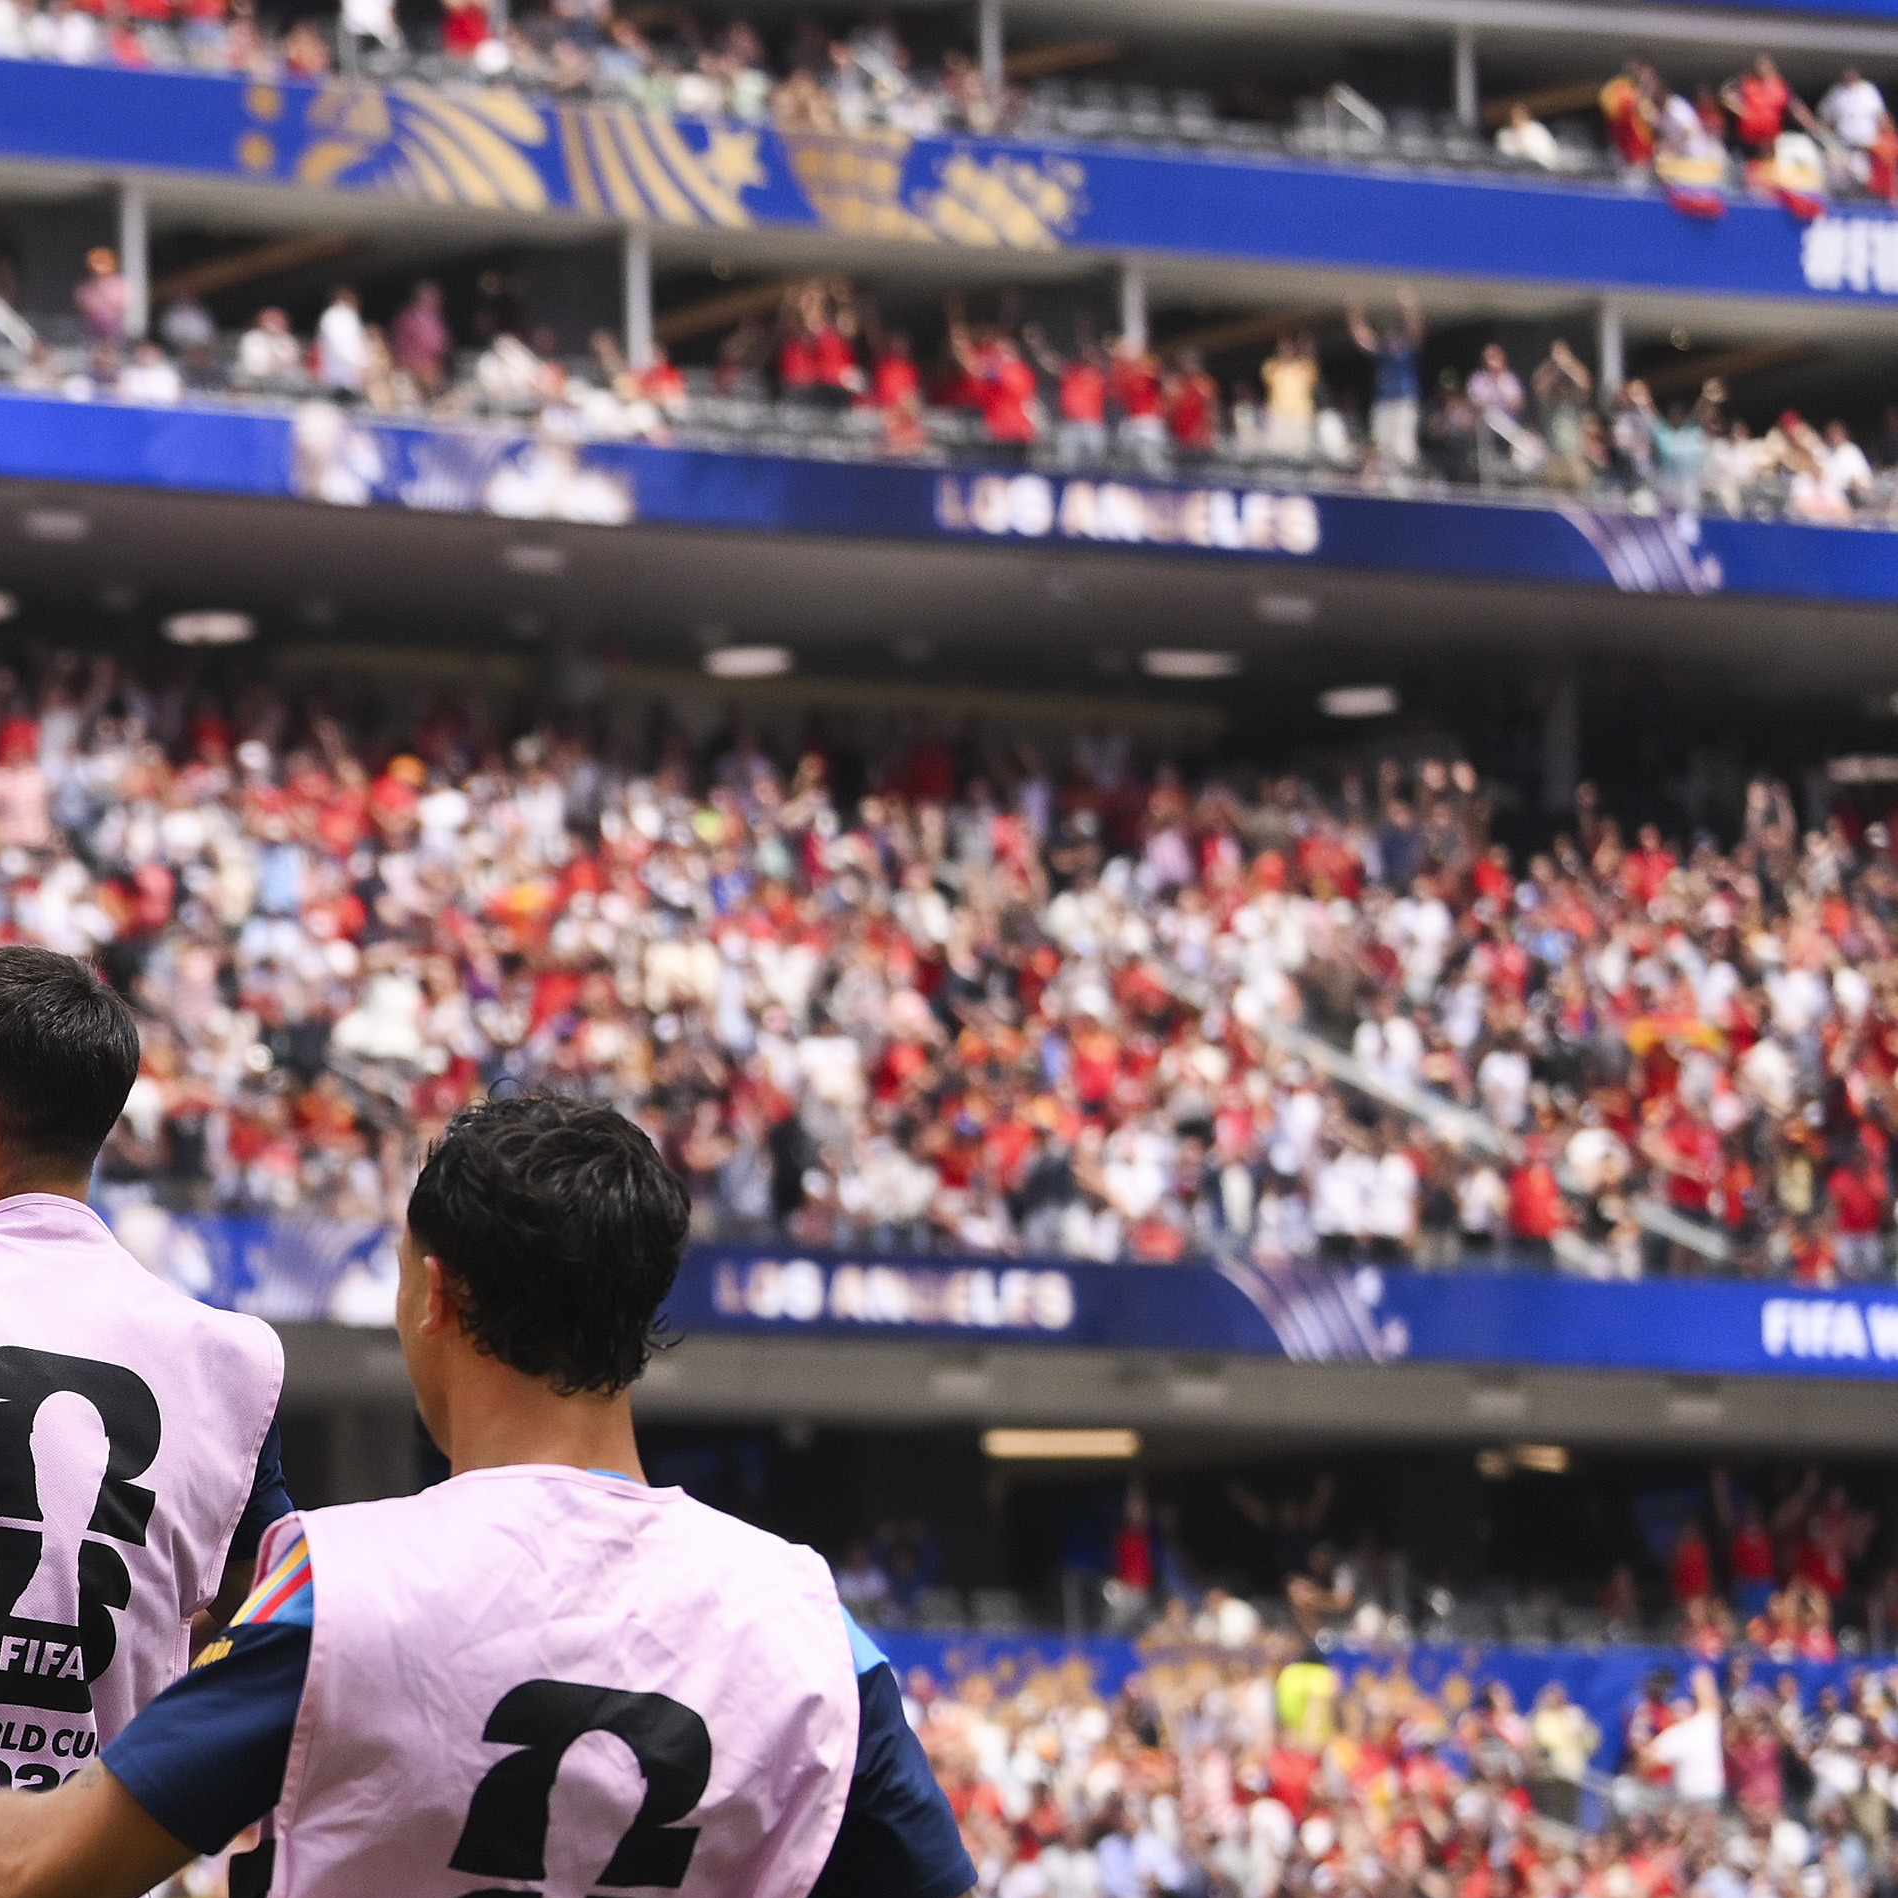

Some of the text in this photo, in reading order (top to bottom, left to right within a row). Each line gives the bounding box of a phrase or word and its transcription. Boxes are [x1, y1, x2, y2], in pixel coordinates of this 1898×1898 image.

[935, 472, 1321, 555] LOS ANGELES
[712, 1257, 1073, 1330] LOS ANGELES
[1761, 1298, 1868, 1359] FIFA
[52, 1729, 99, 1758] CU
